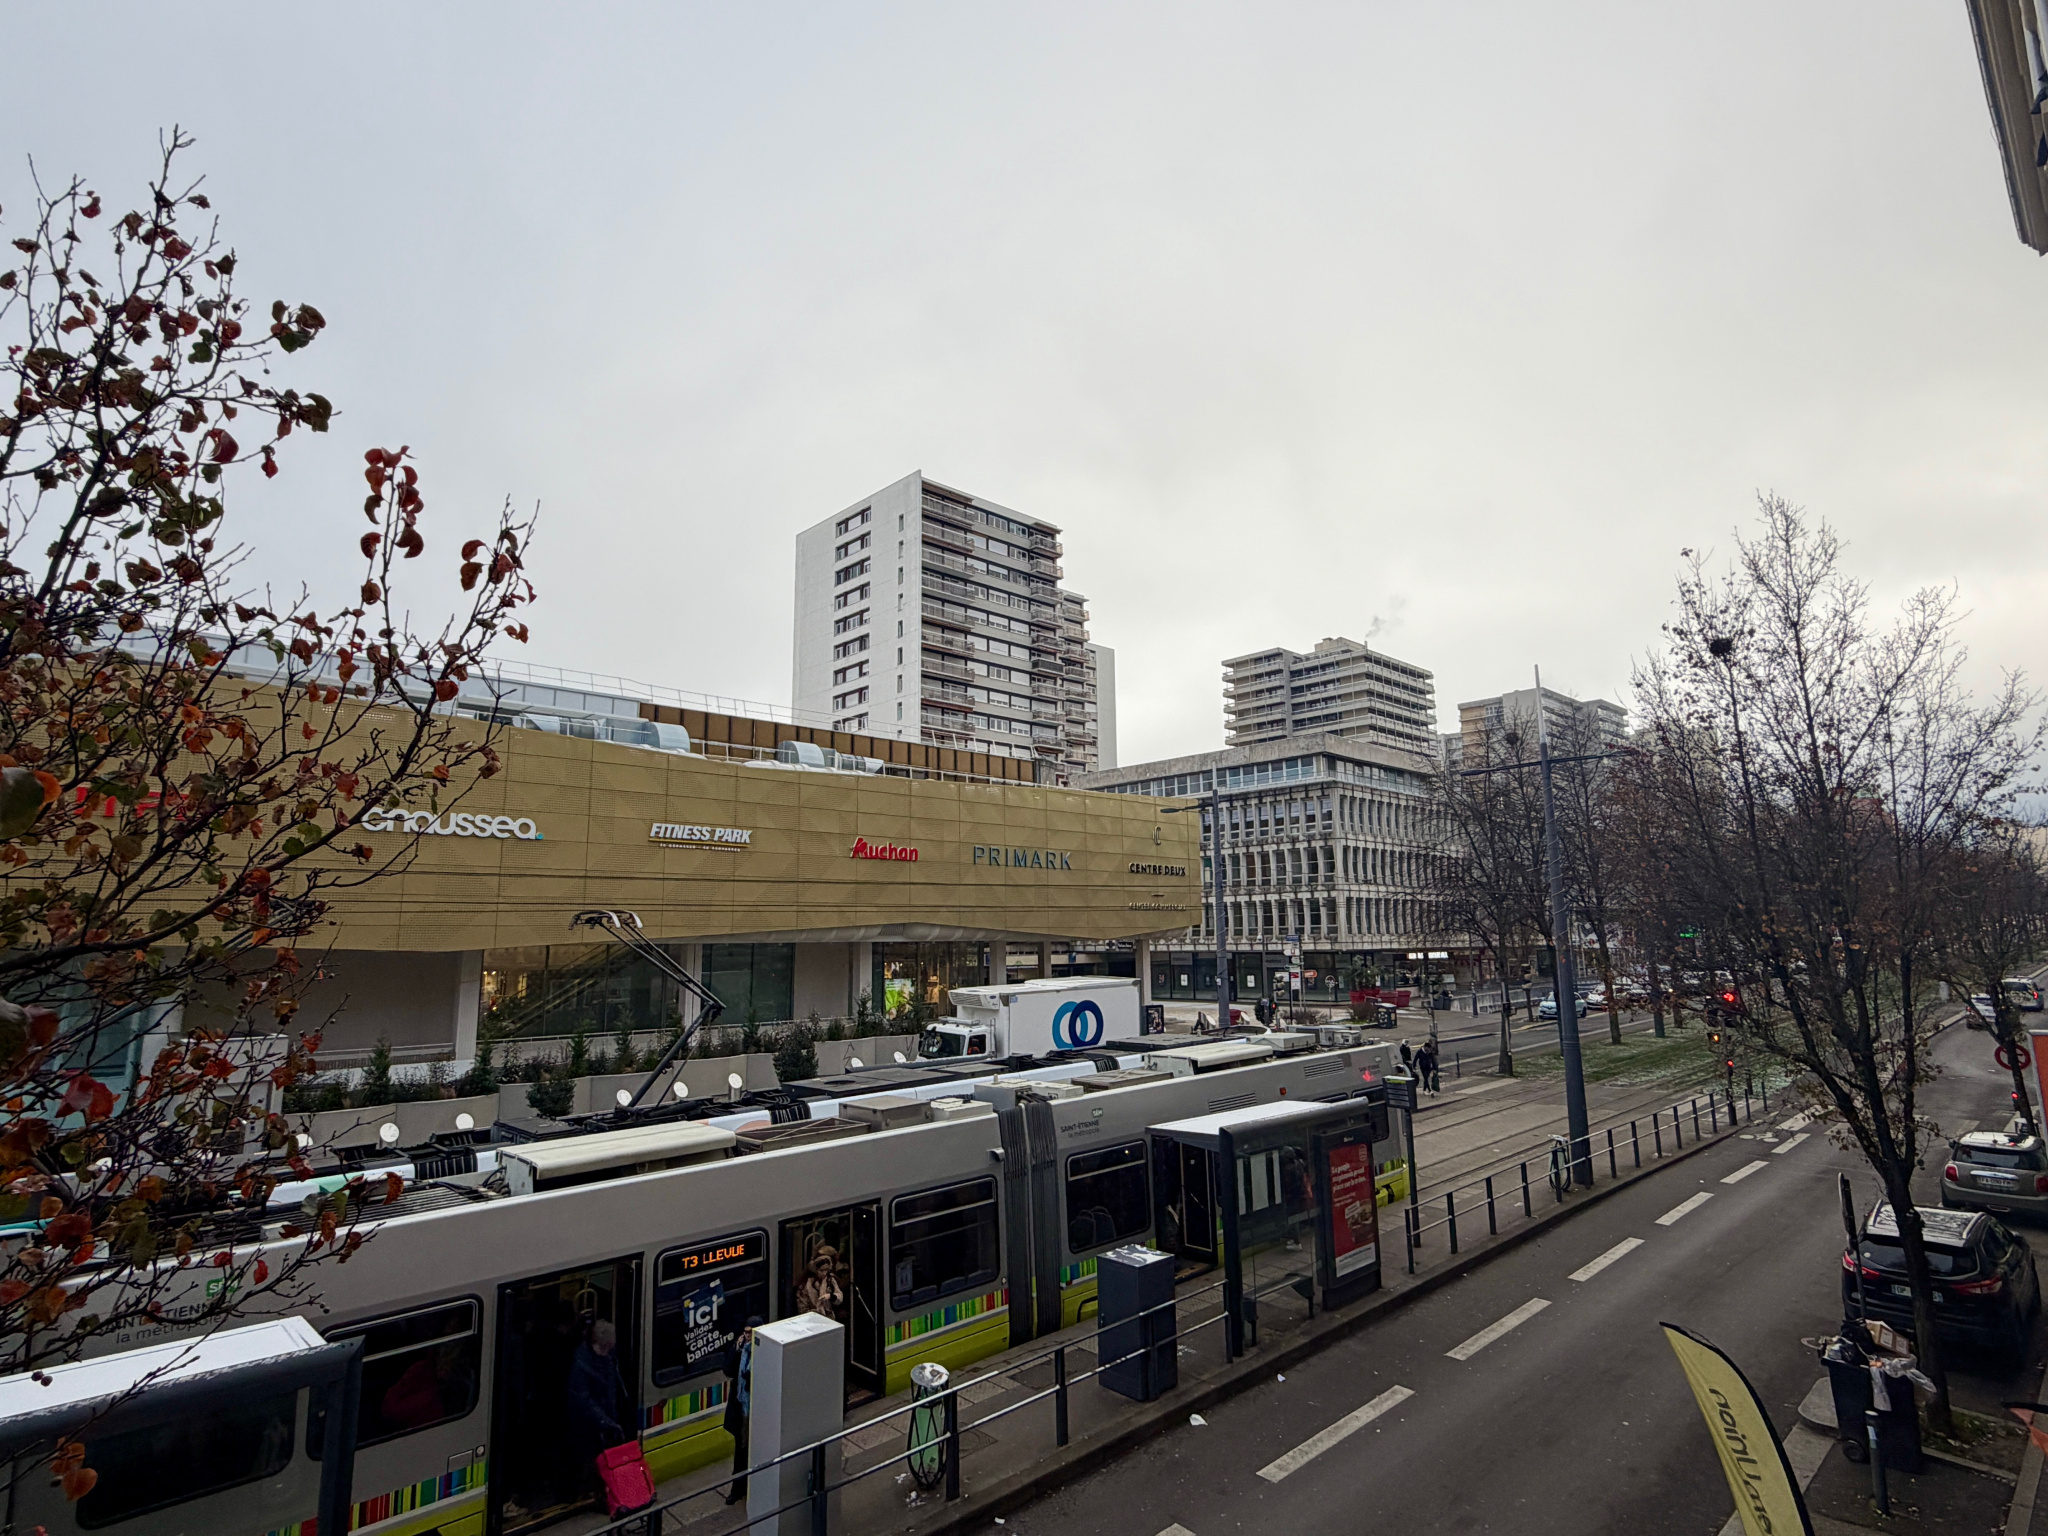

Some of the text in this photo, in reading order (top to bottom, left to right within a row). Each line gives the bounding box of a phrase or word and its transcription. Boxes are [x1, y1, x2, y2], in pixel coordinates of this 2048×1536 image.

[650, 823, 753, 844] FITNESS PARK
[850, 837, 919, 862] Auchan
[973, 845, 1072, 870] PRIMARK
[1128, 862, 1186, 877] CENTRE DEUX
[682, 1244, 745, 1269] T3 LLEVUE
[688, 1294, 719, 1328] ici
[116, 1332, 130, 1344] la
[684, 1322, 713, 1341] Validez
[690, 1331, 720, 1351] carte
[686, 1332, 735, 1364] bancaire
